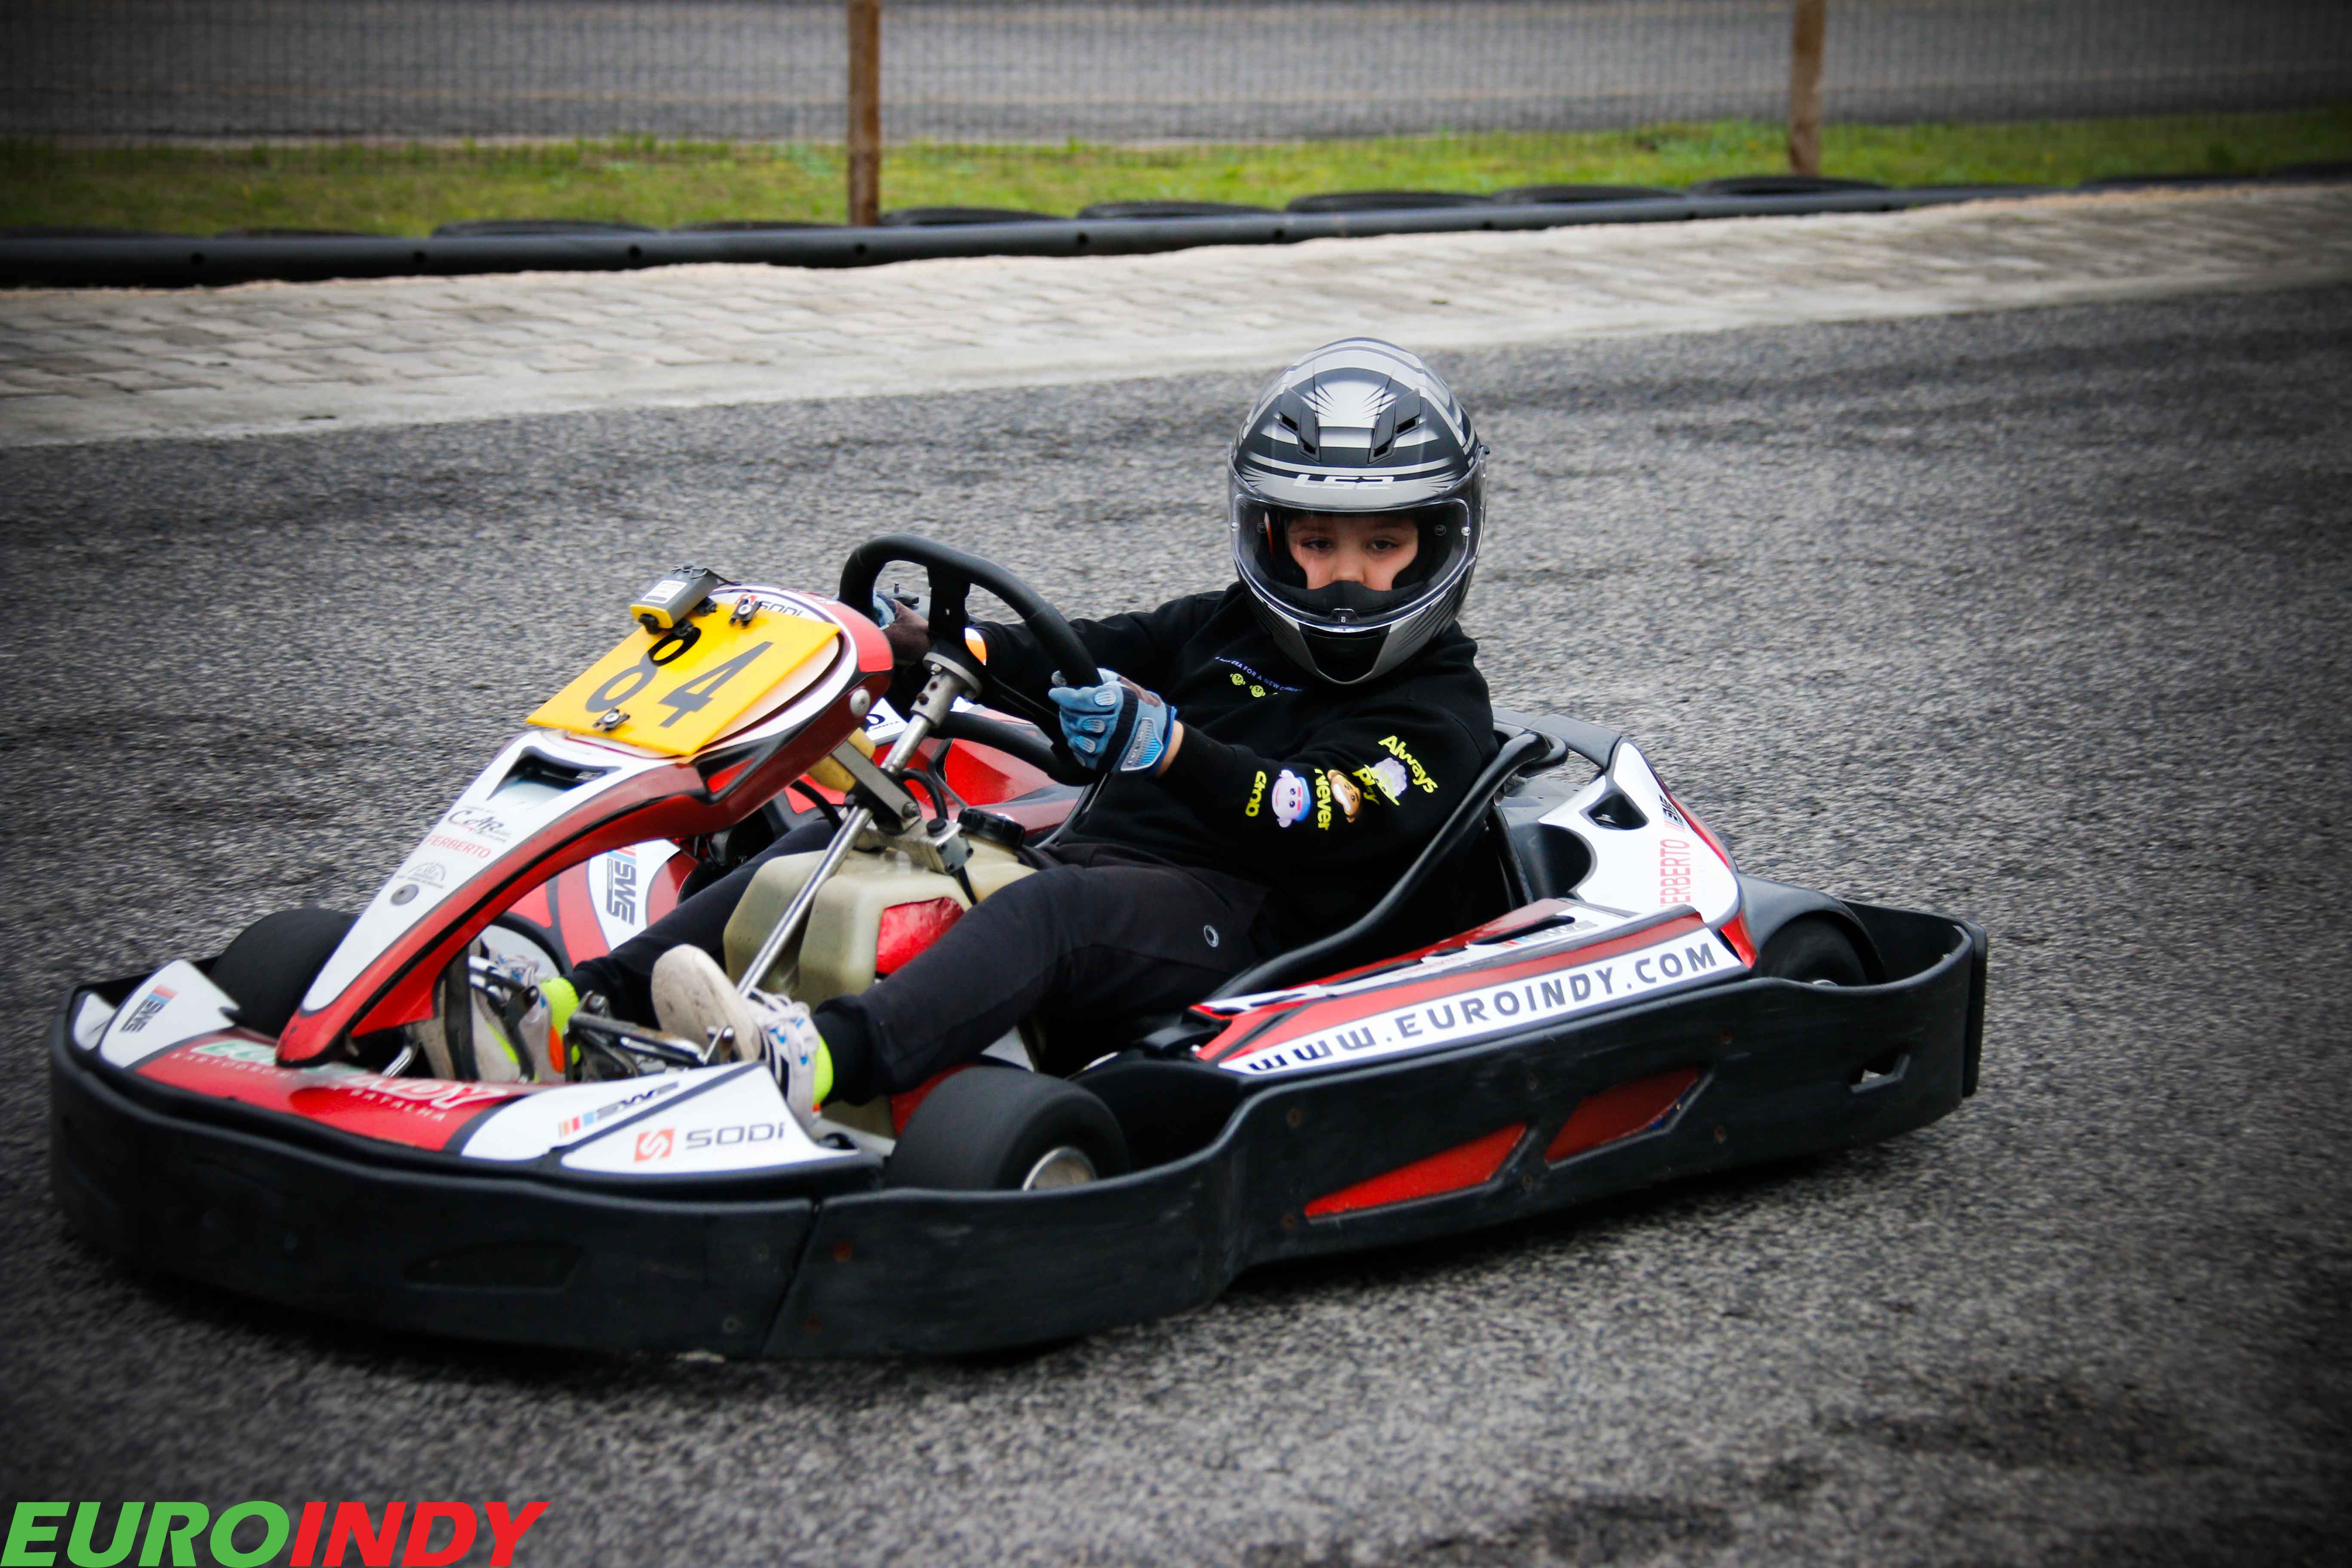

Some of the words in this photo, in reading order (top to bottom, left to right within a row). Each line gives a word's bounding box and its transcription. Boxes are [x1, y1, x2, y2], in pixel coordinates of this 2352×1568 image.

[1293, 474, 1394, 490] LS2
[1243, 666, 1256, 677] FOR
[1264, 678, 1279, 689] NEW
[1378, 735, 1438, 793] Always
[1314, 769, 1332, 830] Never
[607, 859, 636, 927] SWS
[1660, 839, 1691, 905] ERBERTO
[1250, 943, 1717, 1071] WWW.EUROINDY.COM
